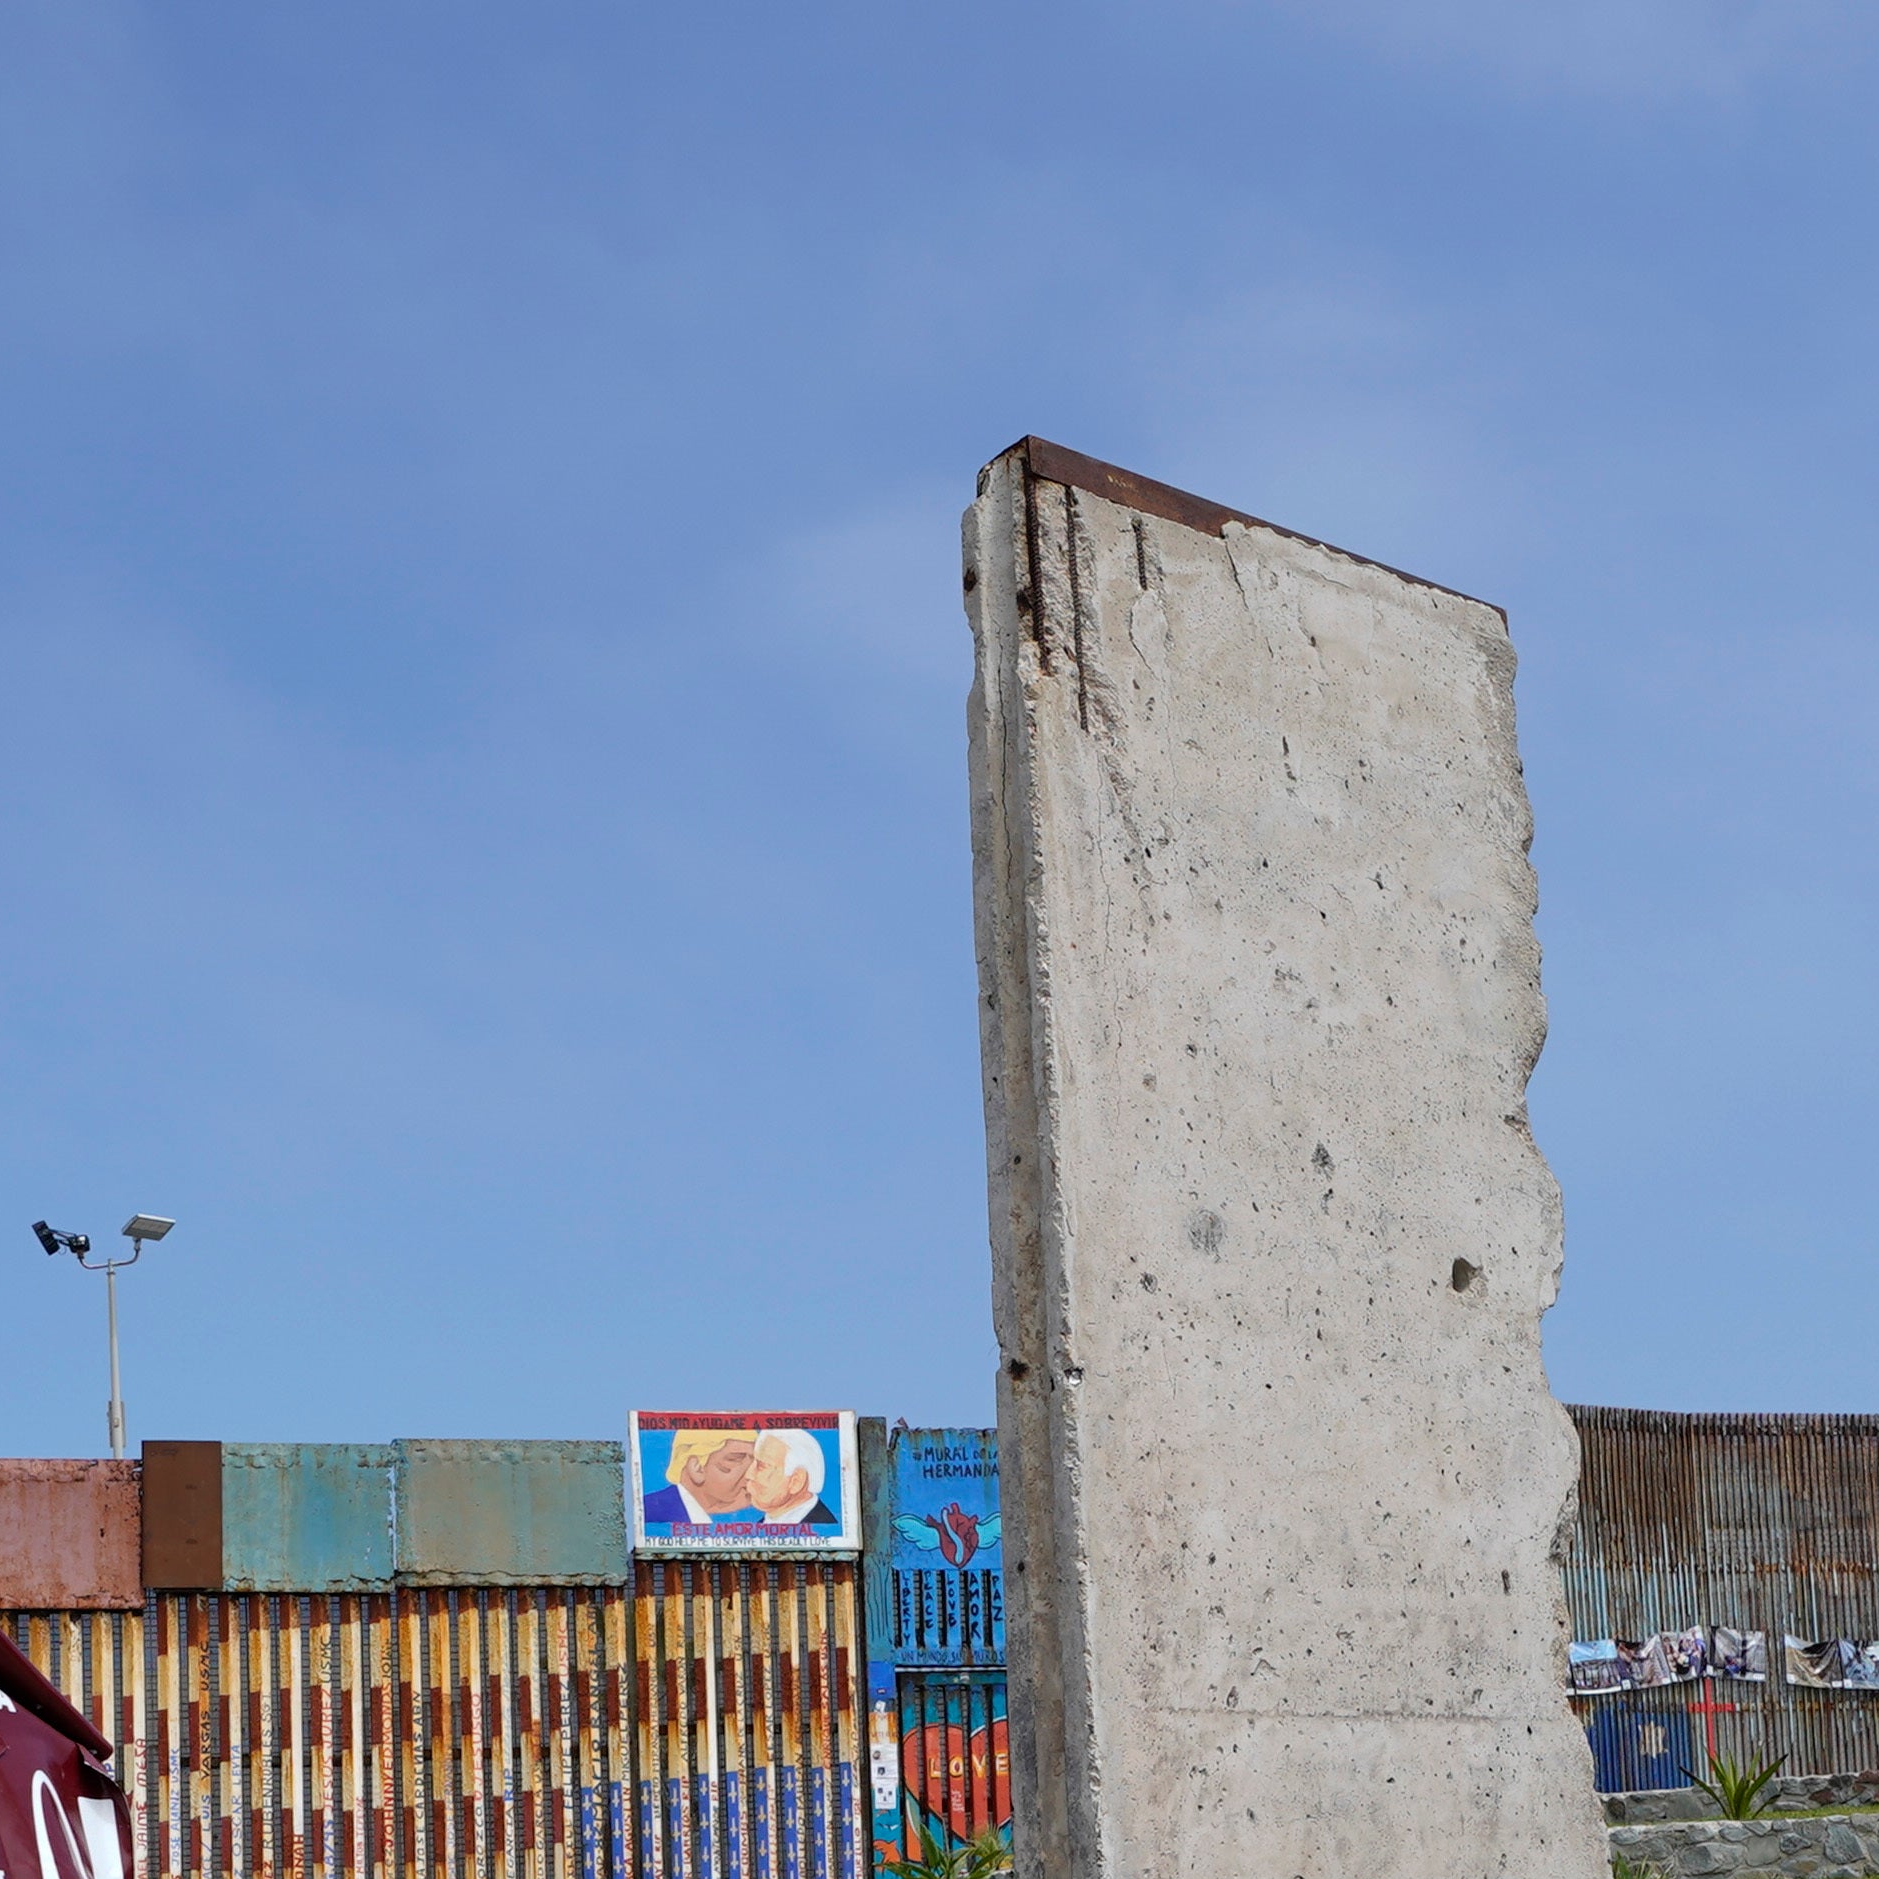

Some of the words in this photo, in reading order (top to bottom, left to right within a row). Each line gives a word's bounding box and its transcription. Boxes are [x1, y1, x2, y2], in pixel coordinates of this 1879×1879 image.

[638, 1418, 665, 1429] DIOS
[765, 1417, 839, 1429] SOBREVIVIR
[673, 1524, 711, 1536] ESTE
[715, 1524, 753, 1536] AMOR
[758, 1523, 817, 1536] MORTAL
[711, 1538, 721, 1546] TO
[723, 1538, 756, 1546] SURVIVE
[778, 1538, 809, 1546] DEADLY
[810, 1538, 830, 1546] LOVE
[924, 1571, 933, 1629] PEACE
[970, 1572, 981, 1639] AMOR
[992, 1576, 1003, 1622] PAZ
[200, 1641, 209, 1691] USMC
[320, 1635, 331, 1684] USMC
[558, 1626, 569, 1677] USMC
[560, 1681, 571, 1740] PEREZ
[200, 1710, 210, 1780] VARGAS
[929, 1751, 1008, 1779] LOVE
[503, 1768, 514, 1801] RIP
[562, 1747, 573, 1808] FELIPE
[681, 1776, 689, 1801] RIP
[201, 1795, 209, 1832] LUIS
[623, 1786, 632, 1850] AGUSTIN
[475, 1806, 486, 1879] OROZCO
